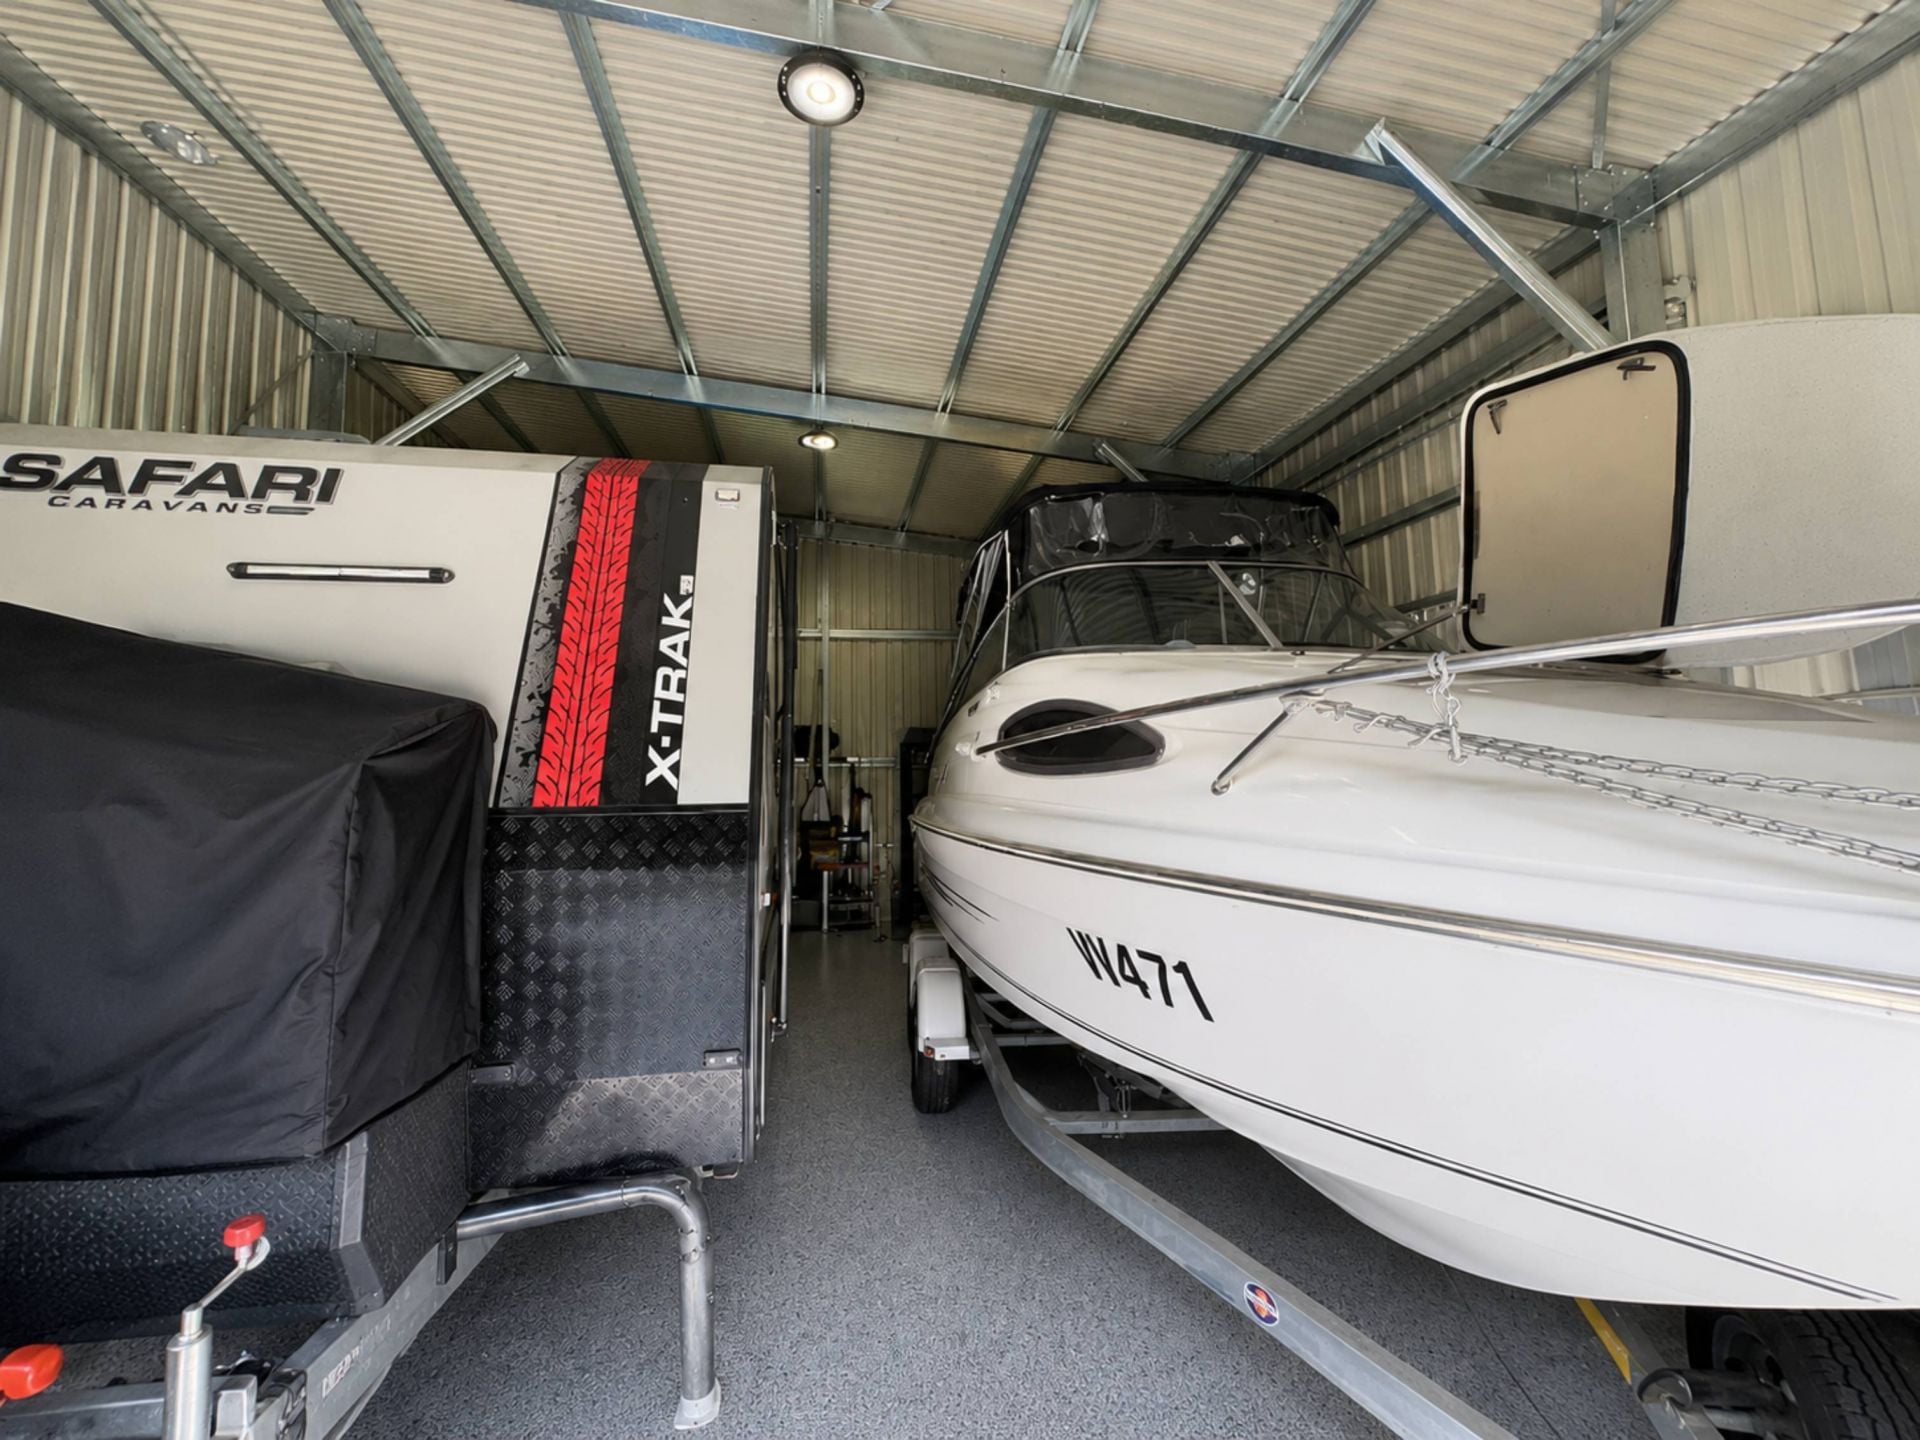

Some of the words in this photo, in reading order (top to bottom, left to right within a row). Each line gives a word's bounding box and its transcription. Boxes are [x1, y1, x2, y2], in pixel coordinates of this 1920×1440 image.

[0, 452, 345, 505] SAFARI
[47, 495, 264, 516] CARAVANS
[1066, 927, 1215, 1023] W471
